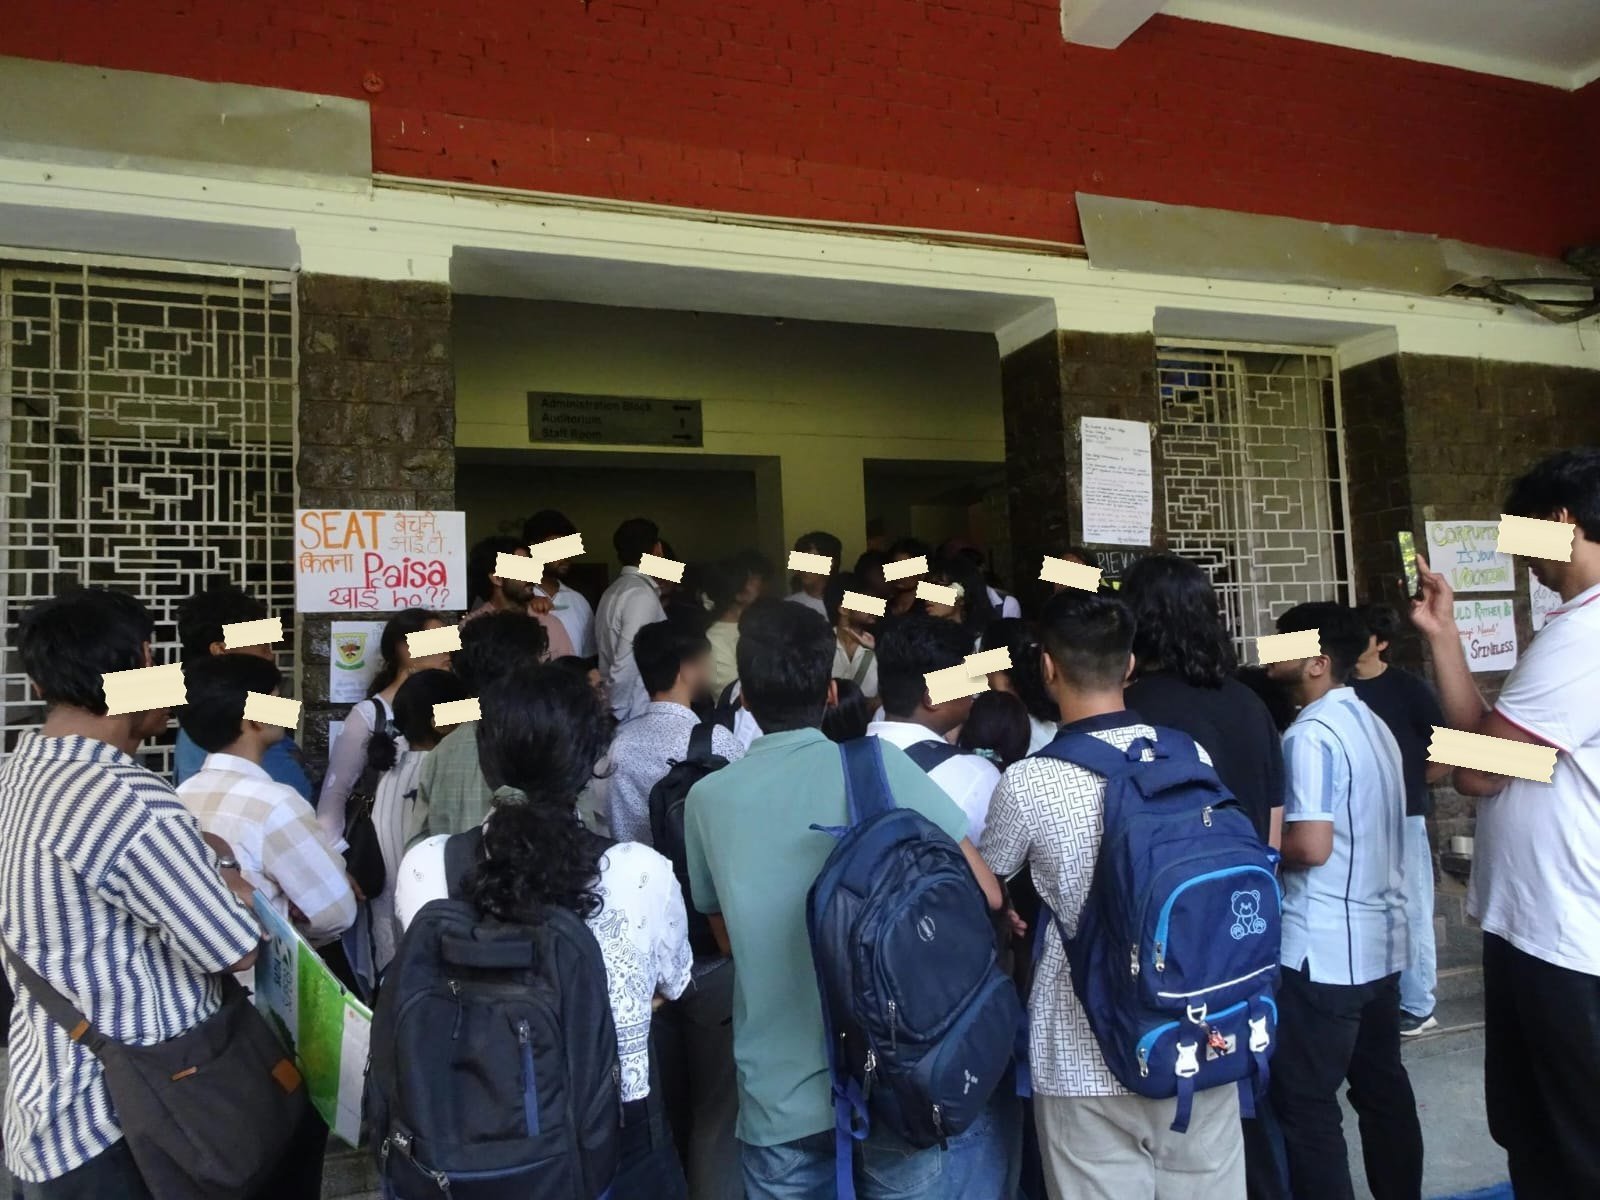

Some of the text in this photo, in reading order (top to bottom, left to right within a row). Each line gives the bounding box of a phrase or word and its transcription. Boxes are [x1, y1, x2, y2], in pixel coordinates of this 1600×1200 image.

[541, 398, 652, 413] Administration Block
[542, 413, 602, 425] Auditorium
[542, 428, 602, 440] Staff Room
[300, 511, 385, 550] SEAT
[300, 551, 353, 574] कितना
[1456, 551, 1473, 564] IS
[364, 552, 447, 589] Paisa
[328, 577, 383, 610] खाई
